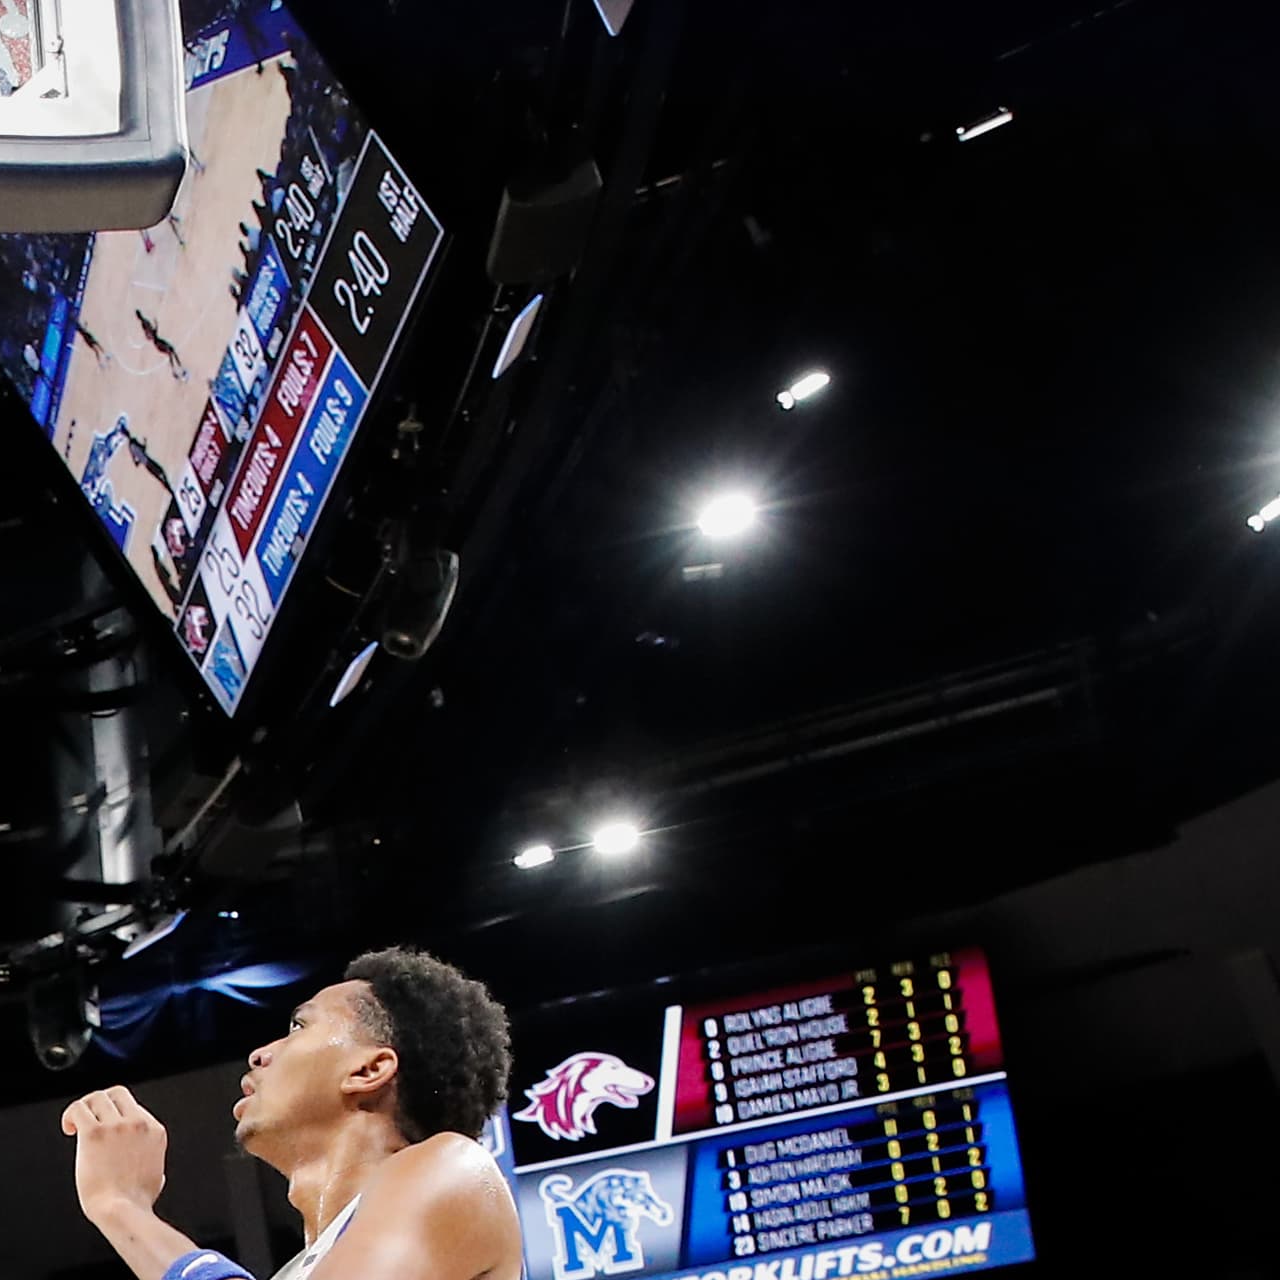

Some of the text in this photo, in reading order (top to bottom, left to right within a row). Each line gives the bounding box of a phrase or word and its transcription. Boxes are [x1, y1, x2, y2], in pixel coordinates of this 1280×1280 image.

[274, 183, 315, 259] 2:40
[389, 186, 420, 242] HALF
[334, 230, 389, 334] 2:40
[234, 328, 260, 370] 32
[205, 533, 239, 596] 25
[235, 580, 271, 640] 32
